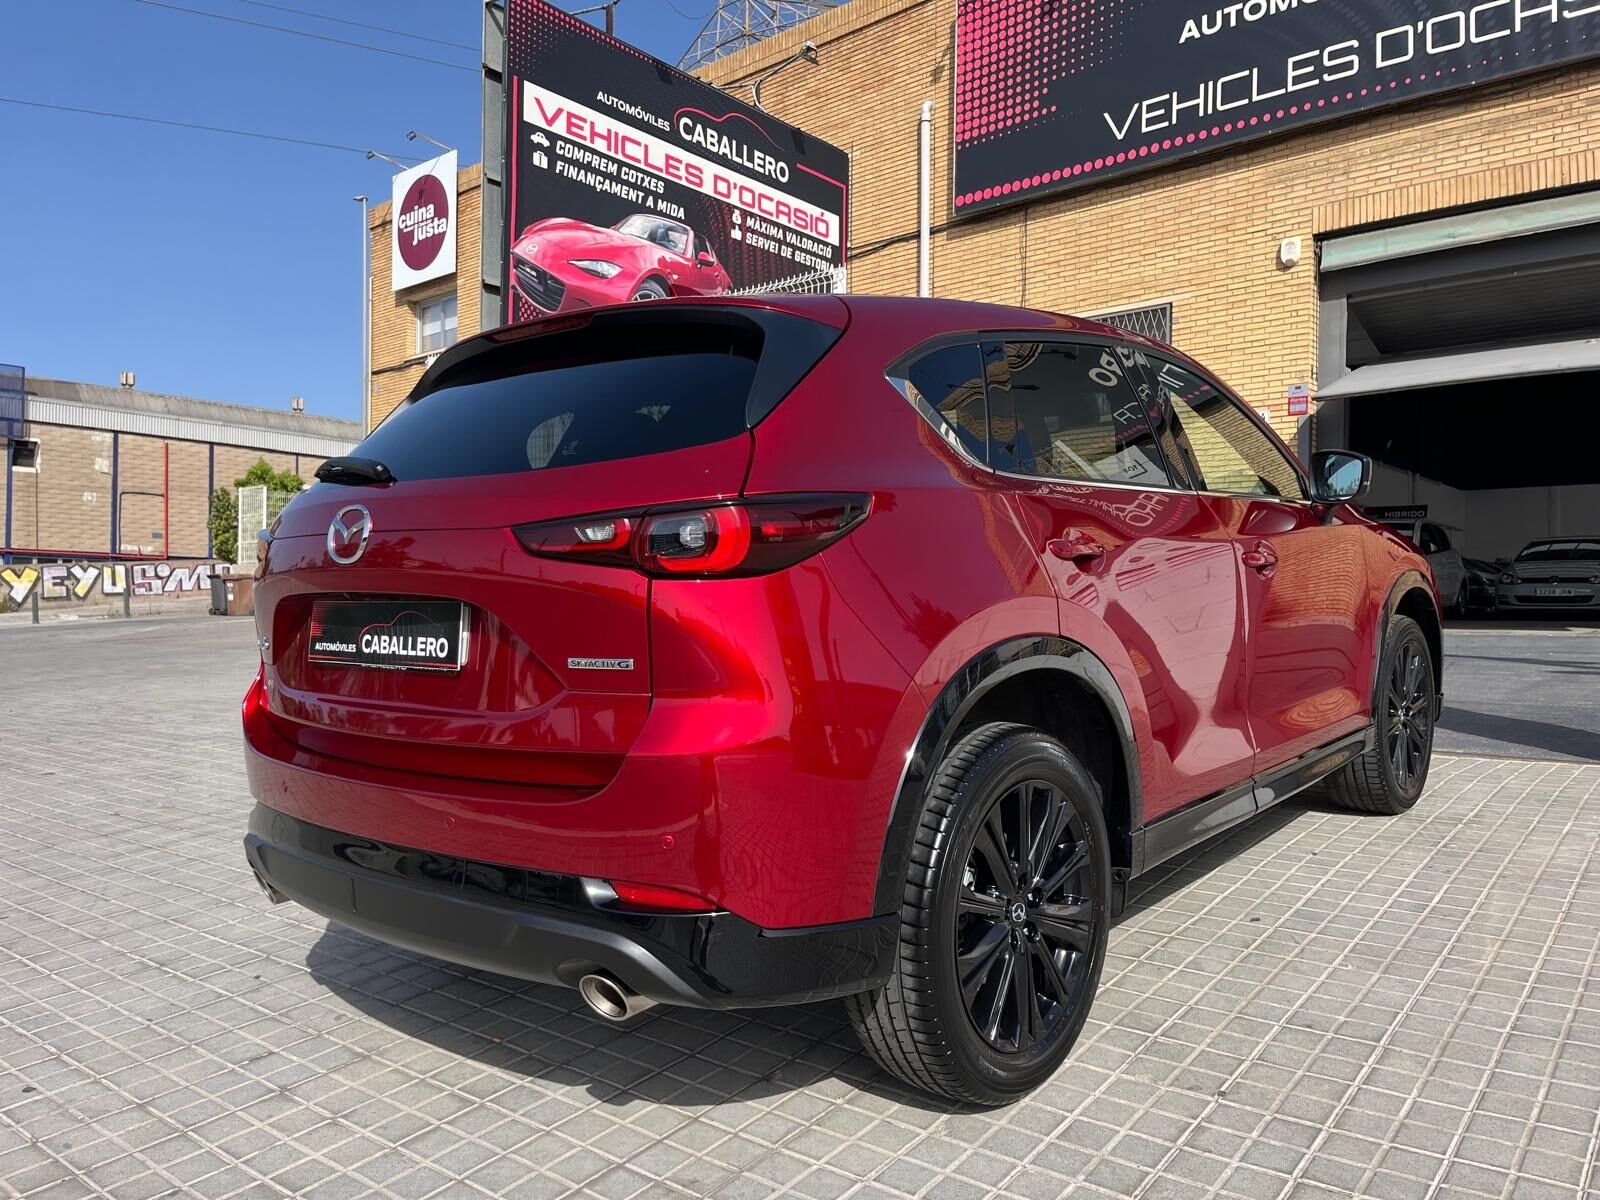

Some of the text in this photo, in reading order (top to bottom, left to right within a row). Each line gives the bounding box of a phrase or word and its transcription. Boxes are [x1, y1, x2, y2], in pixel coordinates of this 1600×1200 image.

[1104, 39, 1360, 141] VEHICLES
[596, 91, 790, 183] AUTOMÓVILES CABALLERO
[533, 96, 830, 239] VEHICLES D'OCASIÓ
[555, 140, 665, 194] COMPREM COTXES
[555, 160, 685, 220] FINANÇAMENT A MIDA
[398, 203, 435, 229] cuina
[412, 217, 447, 246] justa
[746, 215, 832, 259] MÀXIMA VALORACIÓ
[745, 232, 779, 254] SERVEI
[780, 244, 793, 259] DE
[314, 634, 449, 658] AUTOMÓVILES CABALLERO
